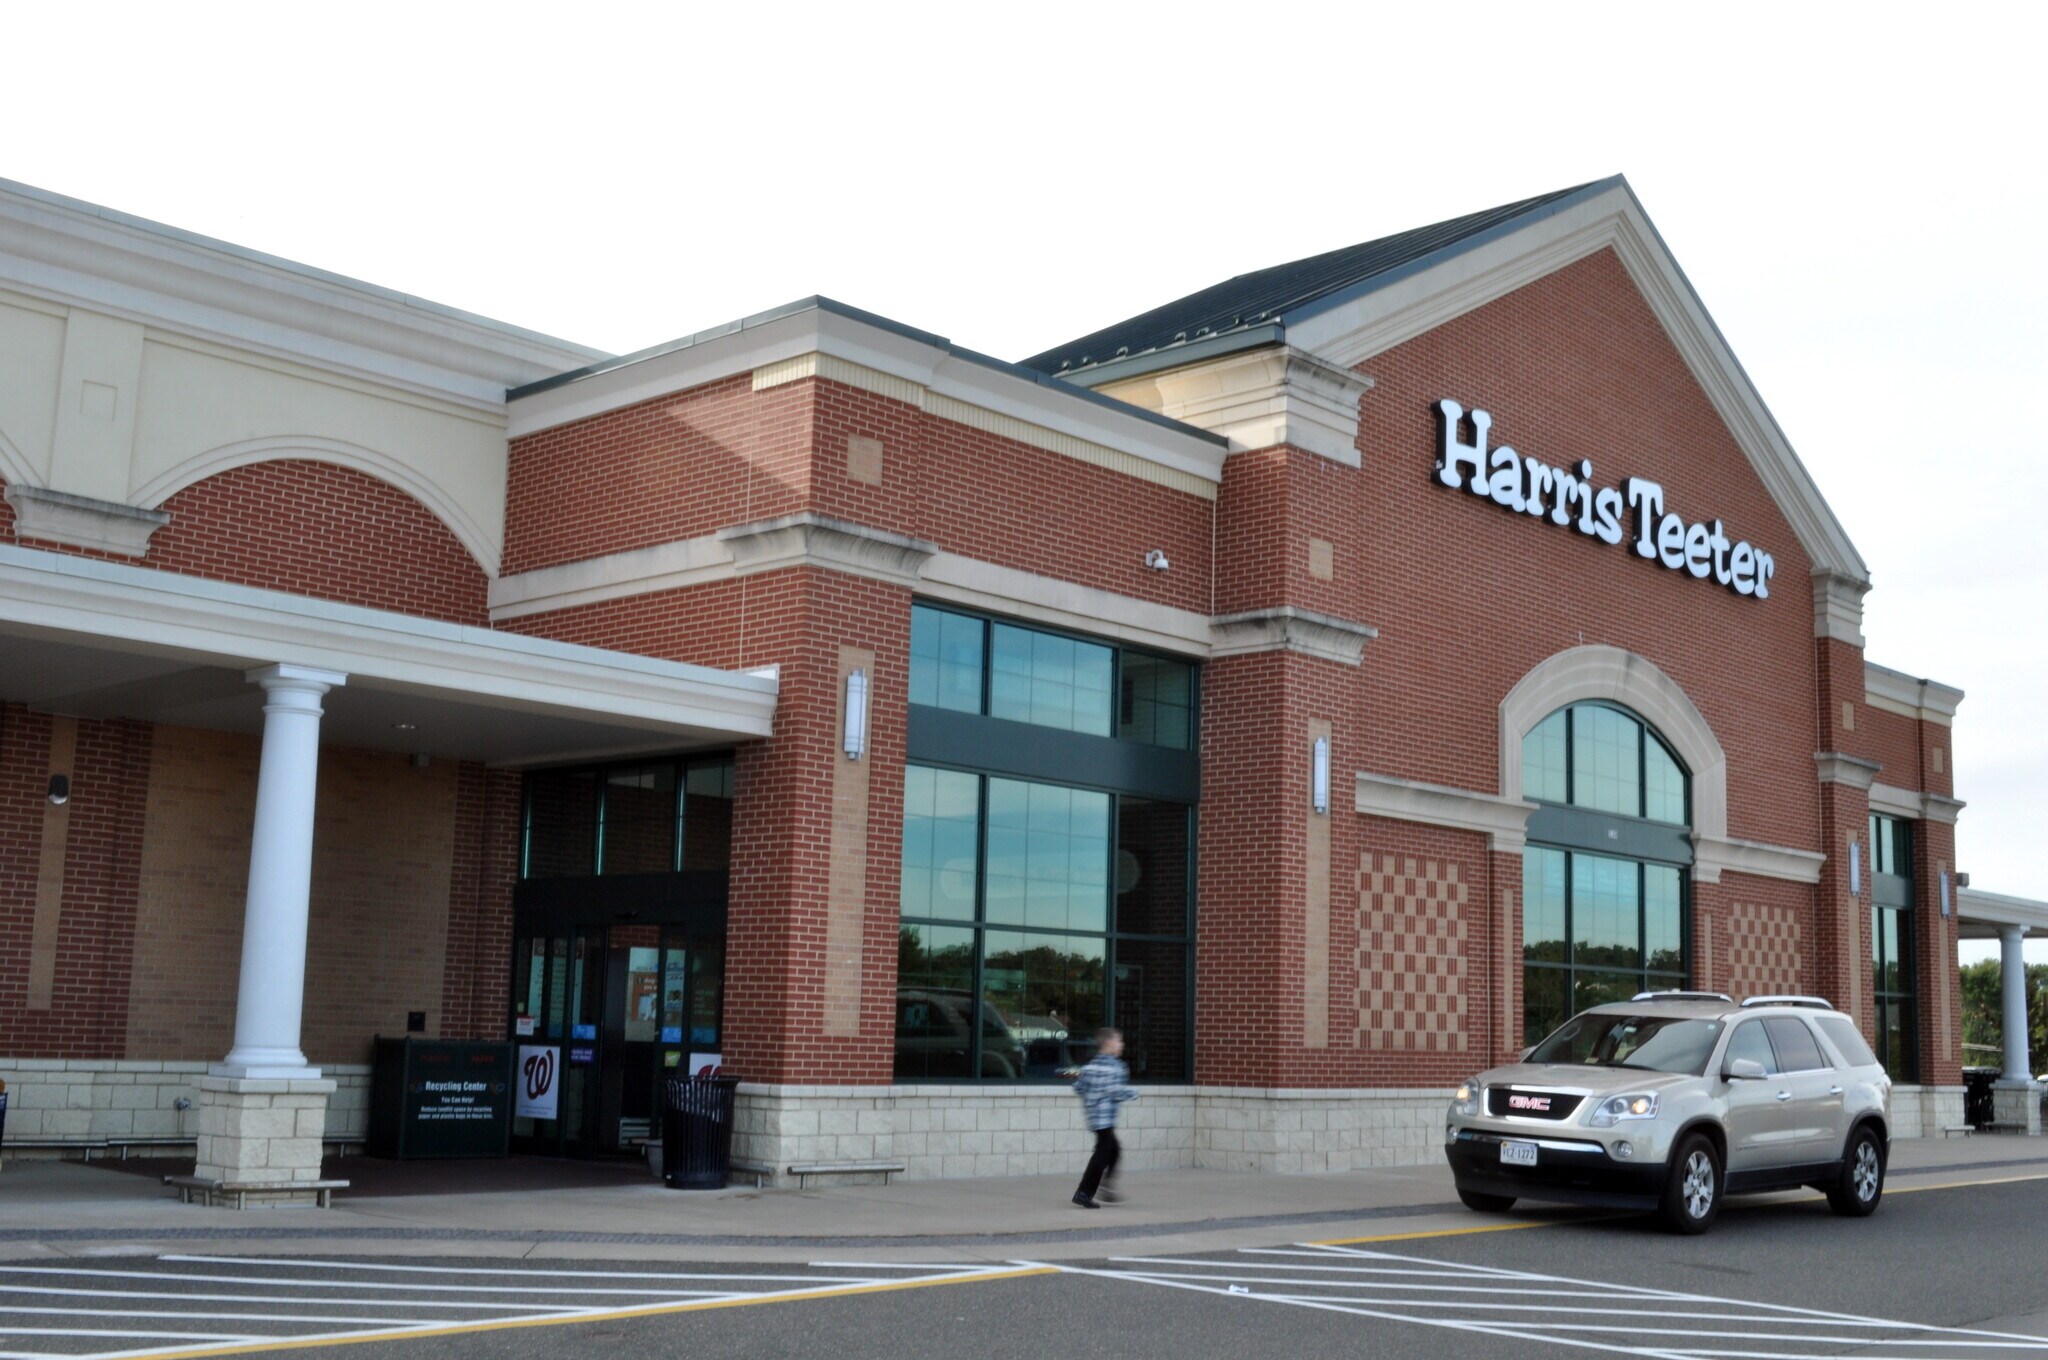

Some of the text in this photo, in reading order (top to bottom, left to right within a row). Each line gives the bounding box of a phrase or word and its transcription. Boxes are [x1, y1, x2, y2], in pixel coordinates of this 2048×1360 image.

[1431, 398, 1775, 600] Harris Teeter
[523, 1049, 554, 1101] W
[425, 1080, 487, 1092] Recycling Center
[451, 1096, 461, 1104] Can
[1509, 1095, 1552, 1111] GMC
